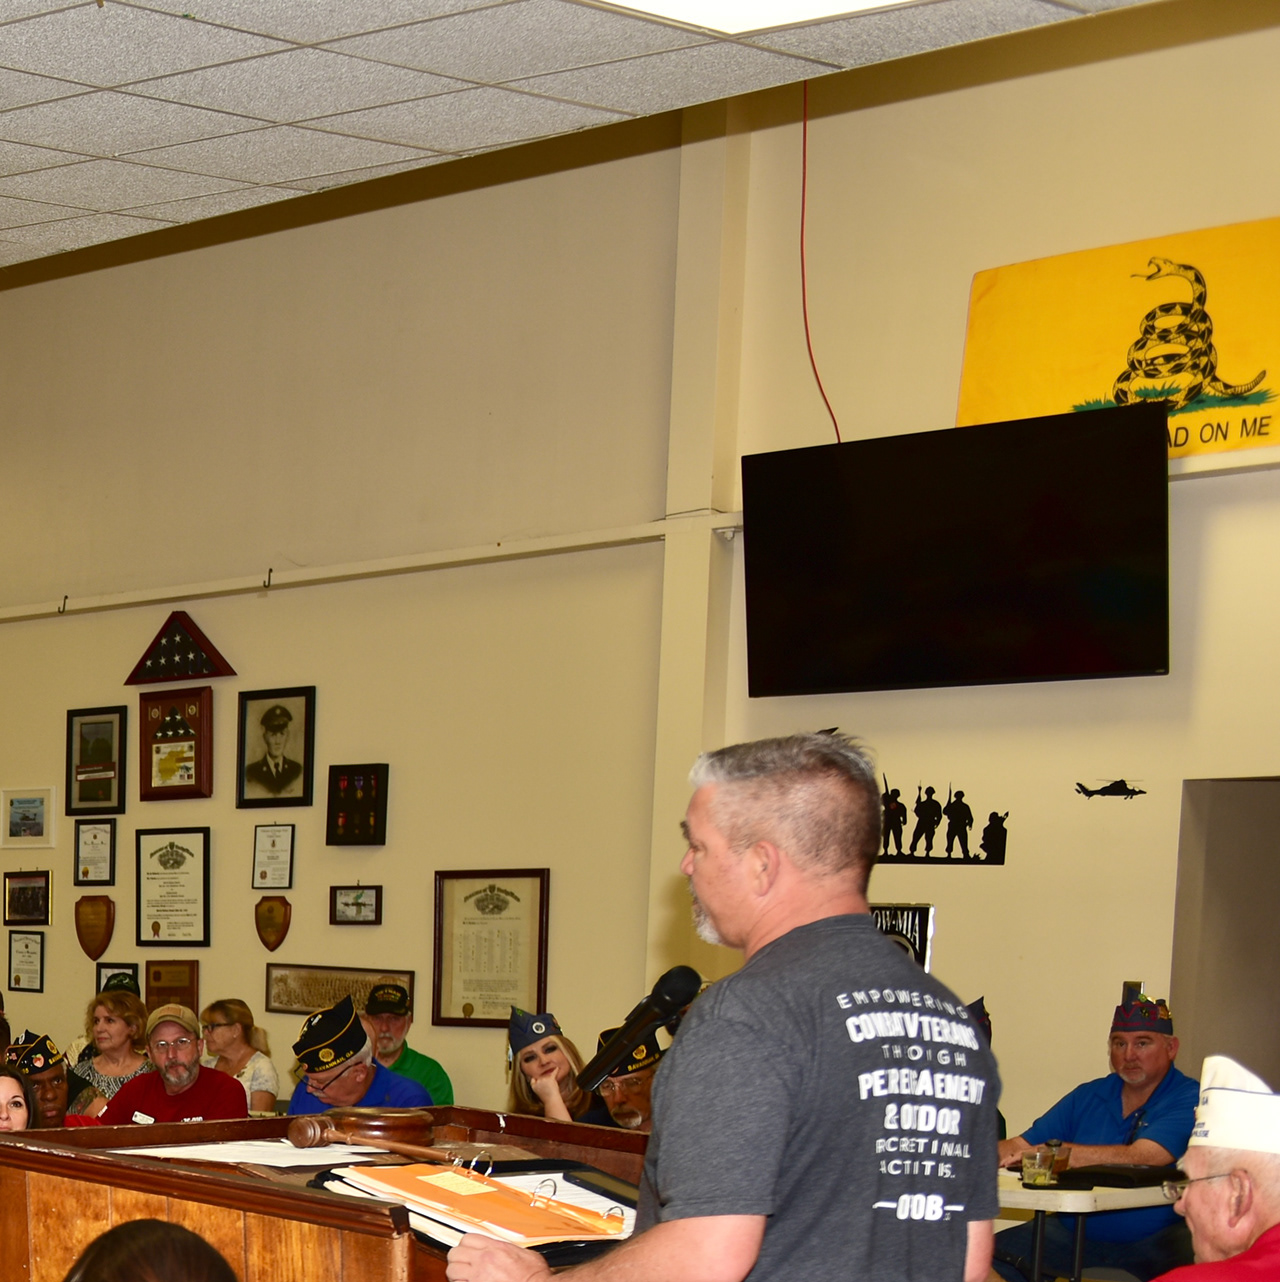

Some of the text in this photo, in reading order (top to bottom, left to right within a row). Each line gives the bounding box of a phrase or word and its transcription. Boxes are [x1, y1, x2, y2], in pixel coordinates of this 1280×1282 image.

[1199, 421, 1229, 443] ON
[1240, 415, 1272, 438] ME
[871, 910, 920, 952] OW-MIA
[836, 988, 968, 1019] EMPOWERING
